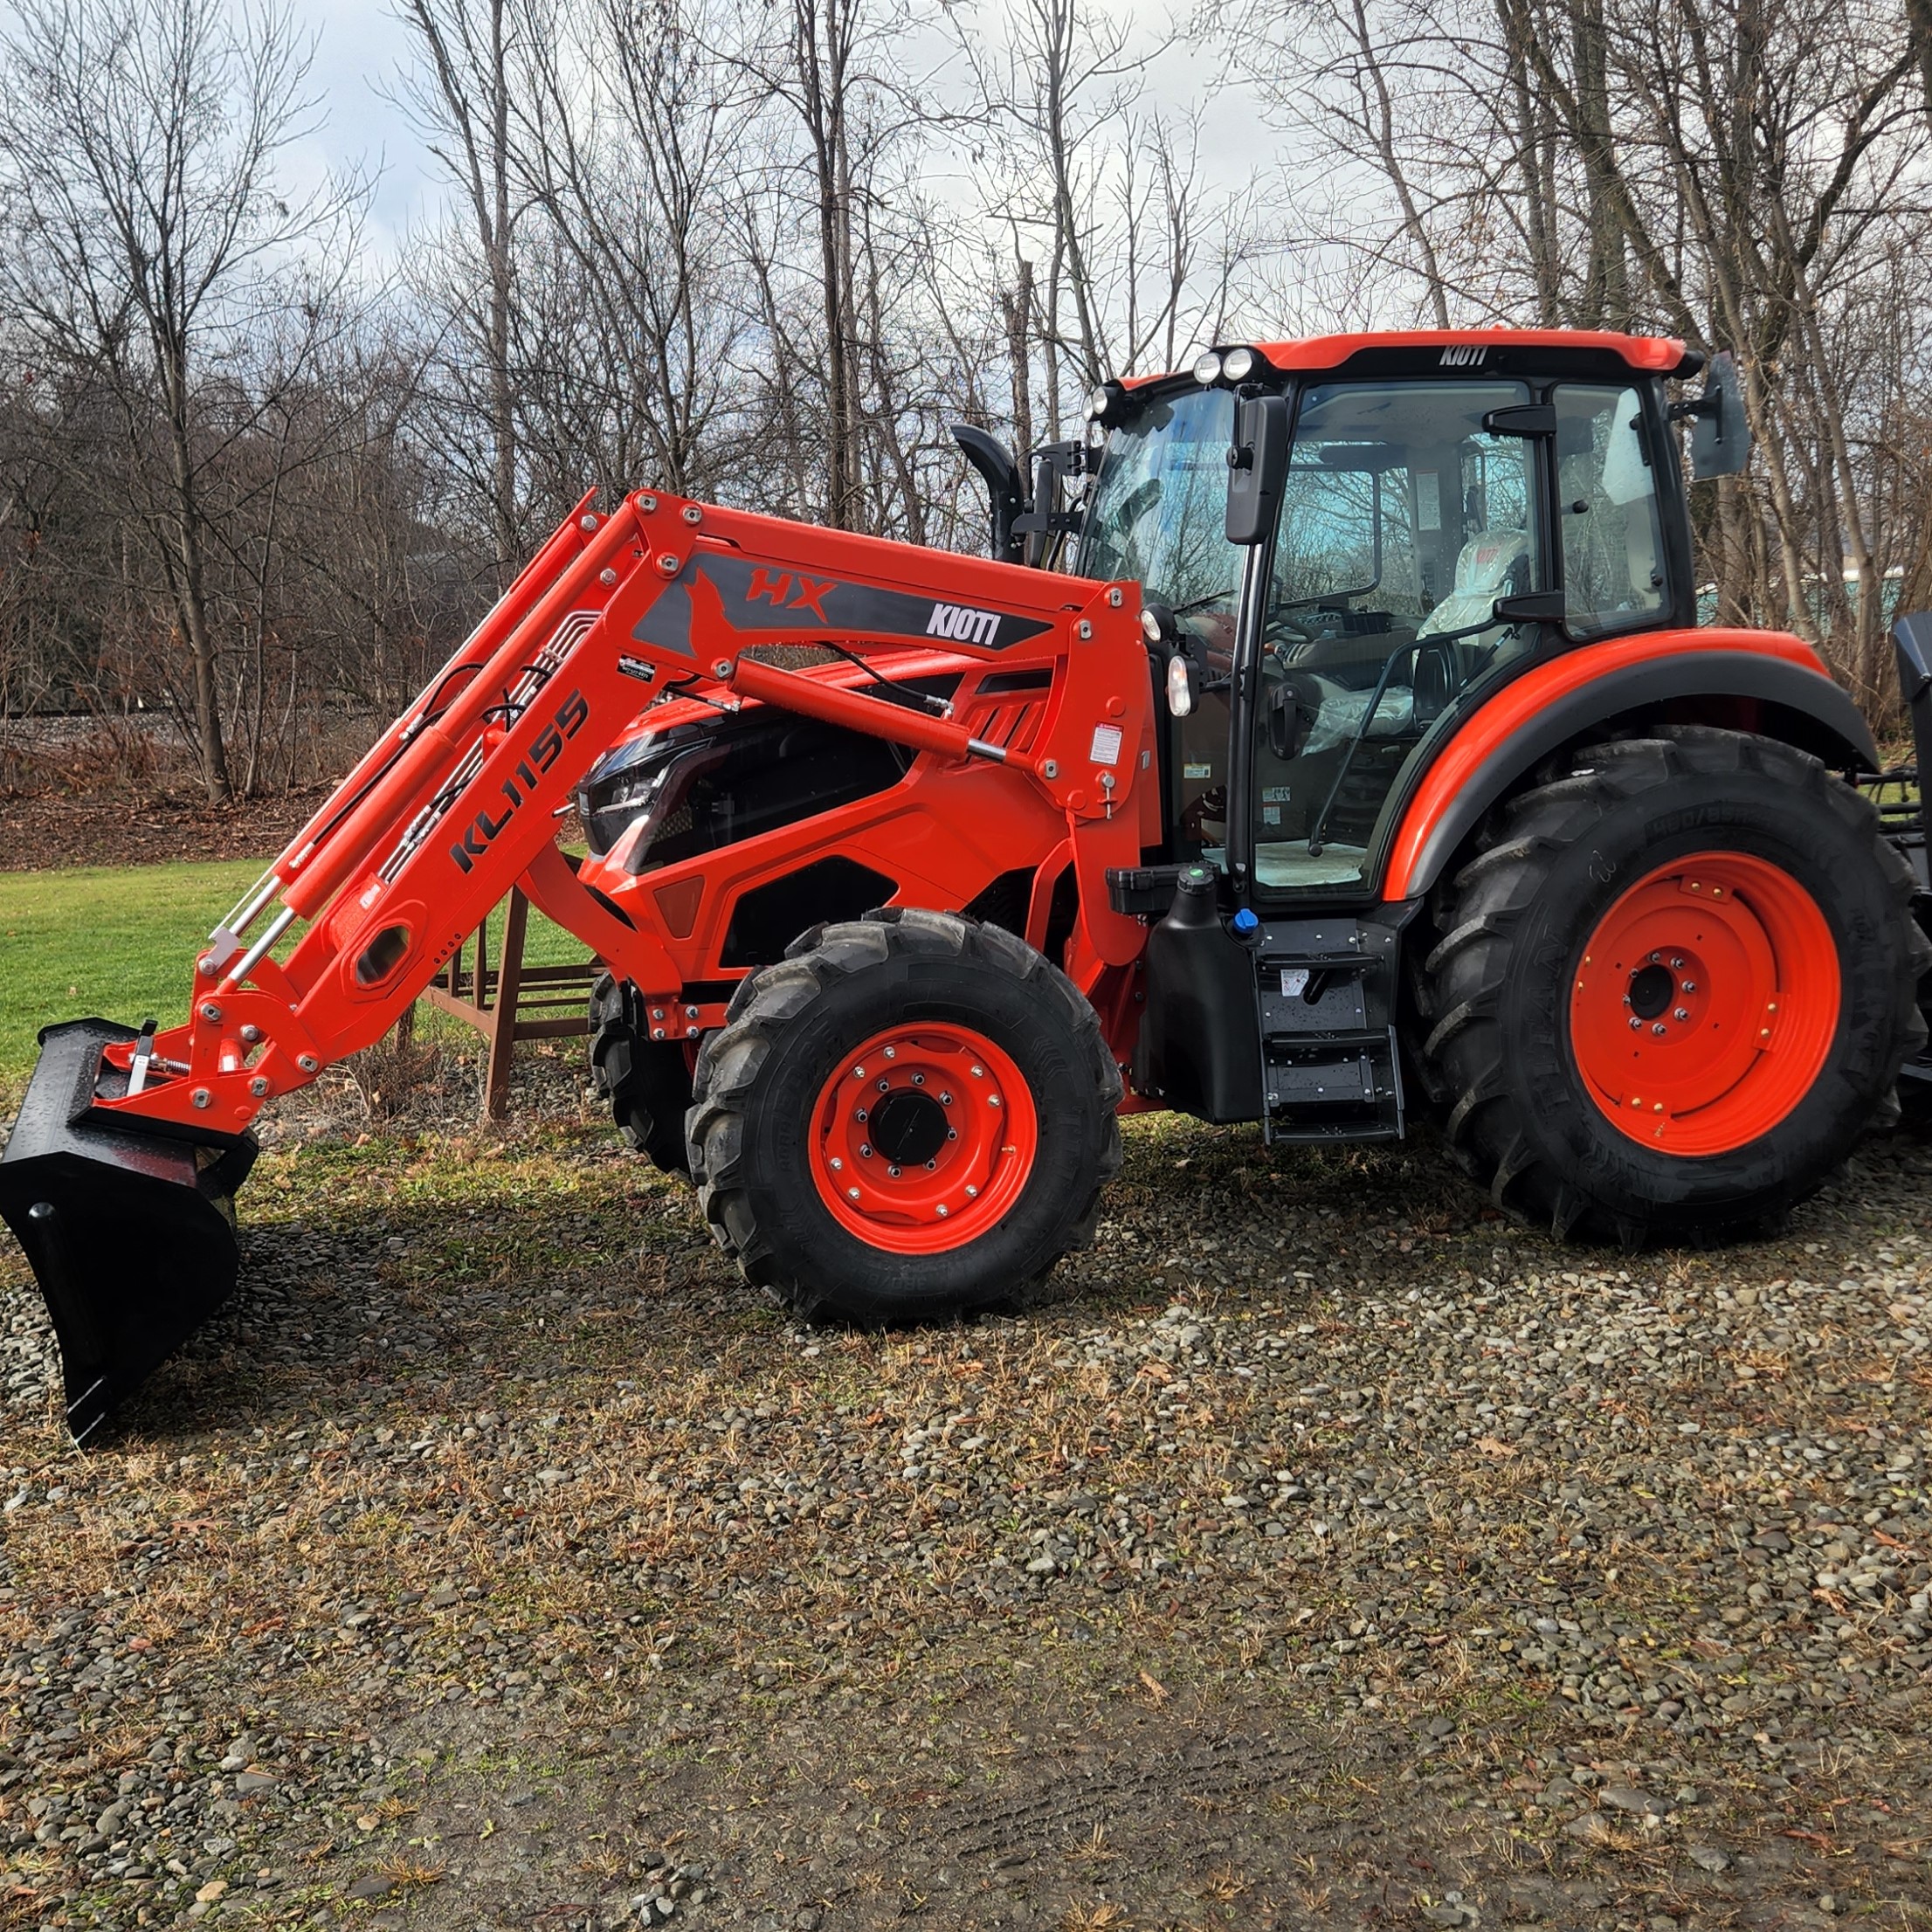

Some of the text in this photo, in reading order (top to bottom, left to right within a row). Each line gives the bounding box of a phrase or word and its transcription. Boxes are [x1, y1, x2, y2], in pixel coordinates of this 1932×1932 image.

[1439, 343, 1488, 366] KIOTI
[746, 568, 838, 624] HX
[926, 603, 1002, 645] KIOTI
[449, 687, 590, 874] KL1155
